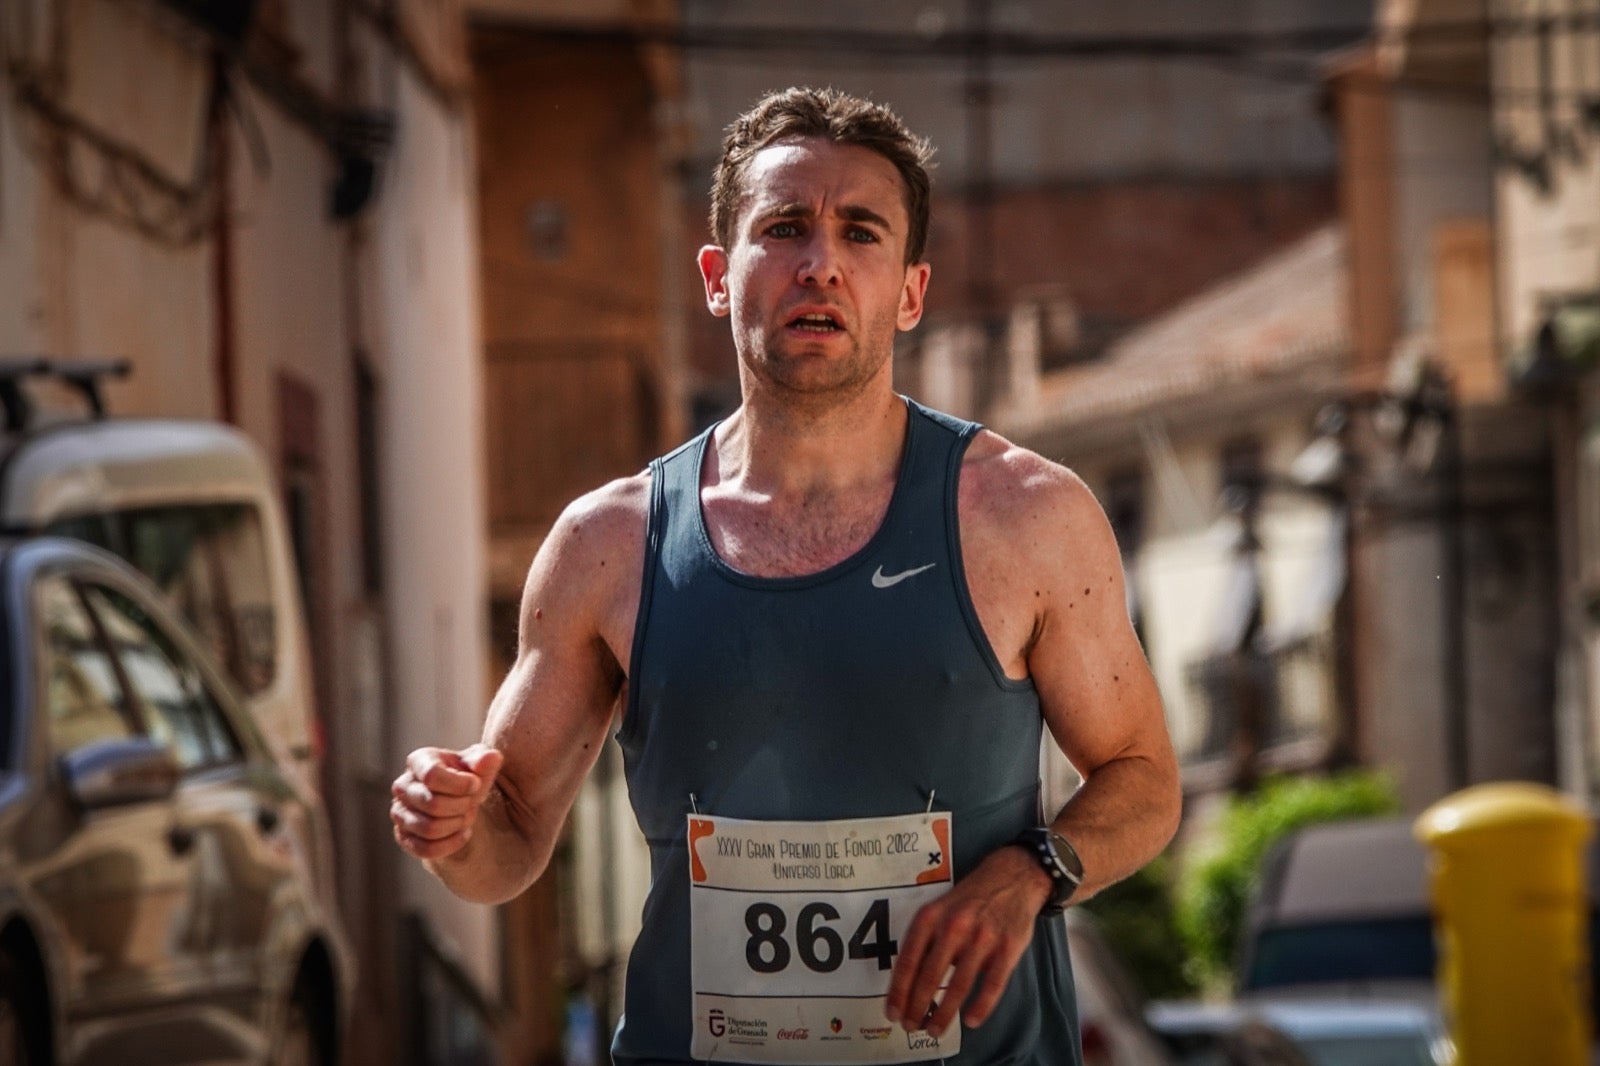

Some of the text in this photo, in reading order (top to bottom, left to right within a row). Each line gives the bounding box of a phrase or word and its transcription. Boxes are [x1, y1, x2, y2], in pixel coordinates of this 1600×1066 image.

[716, 832, 919, 859] XXXV GRAN PREMIO DE FONDO 2022
[773, 862, 855, 879] UNIVERSO LORCA
[744, 898, 898, 973] 864
